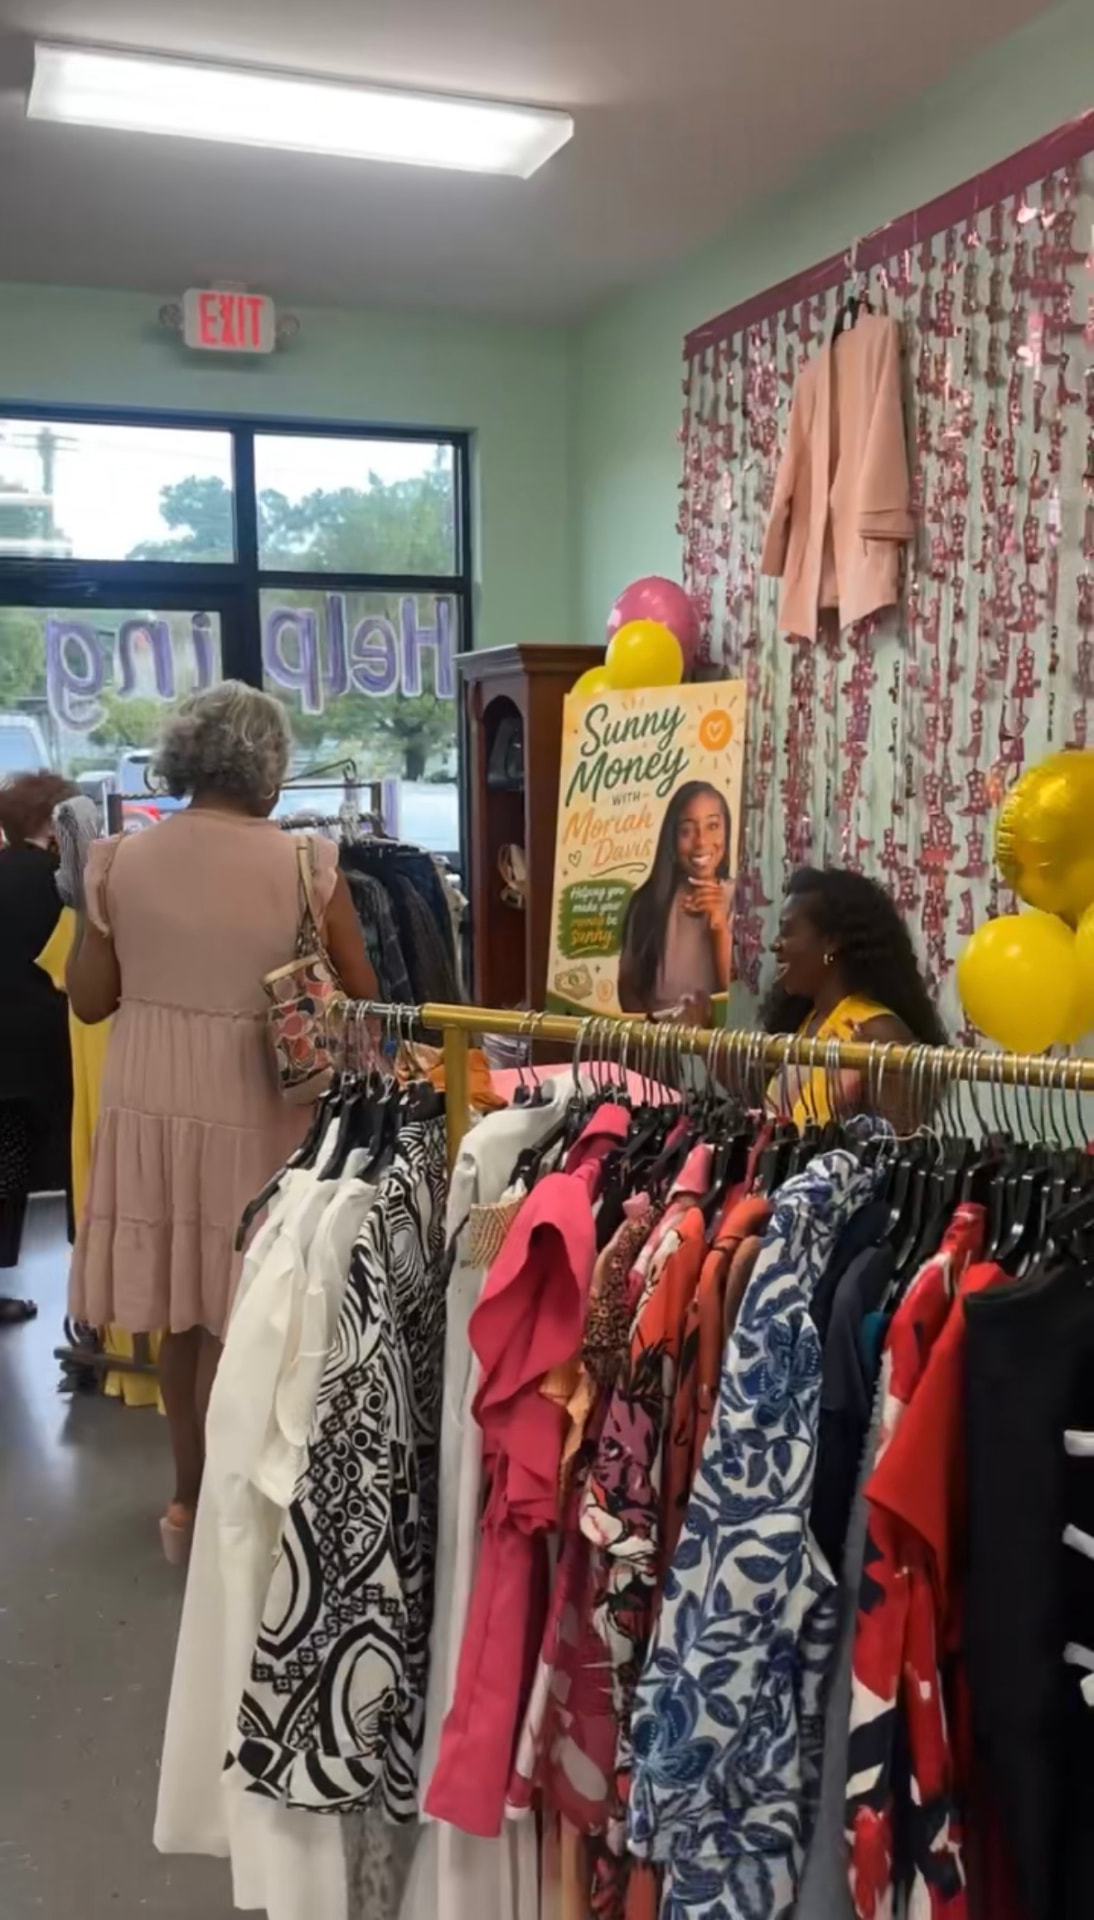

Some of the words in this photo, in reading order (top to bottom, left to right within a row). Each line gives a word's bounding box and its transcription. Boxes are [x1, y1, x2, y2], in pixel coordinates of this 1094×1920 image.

[199, 292, 264, 350] EXIT
[580, 703, 686, 757] Sunny
[565, 747, 689, 807] Money
[612, 791, 640, 806] WITH
[562, 803, 653, 845] Moriah
[593, 837, 652, 867] Davis
[606, 886, 626, 901] you
